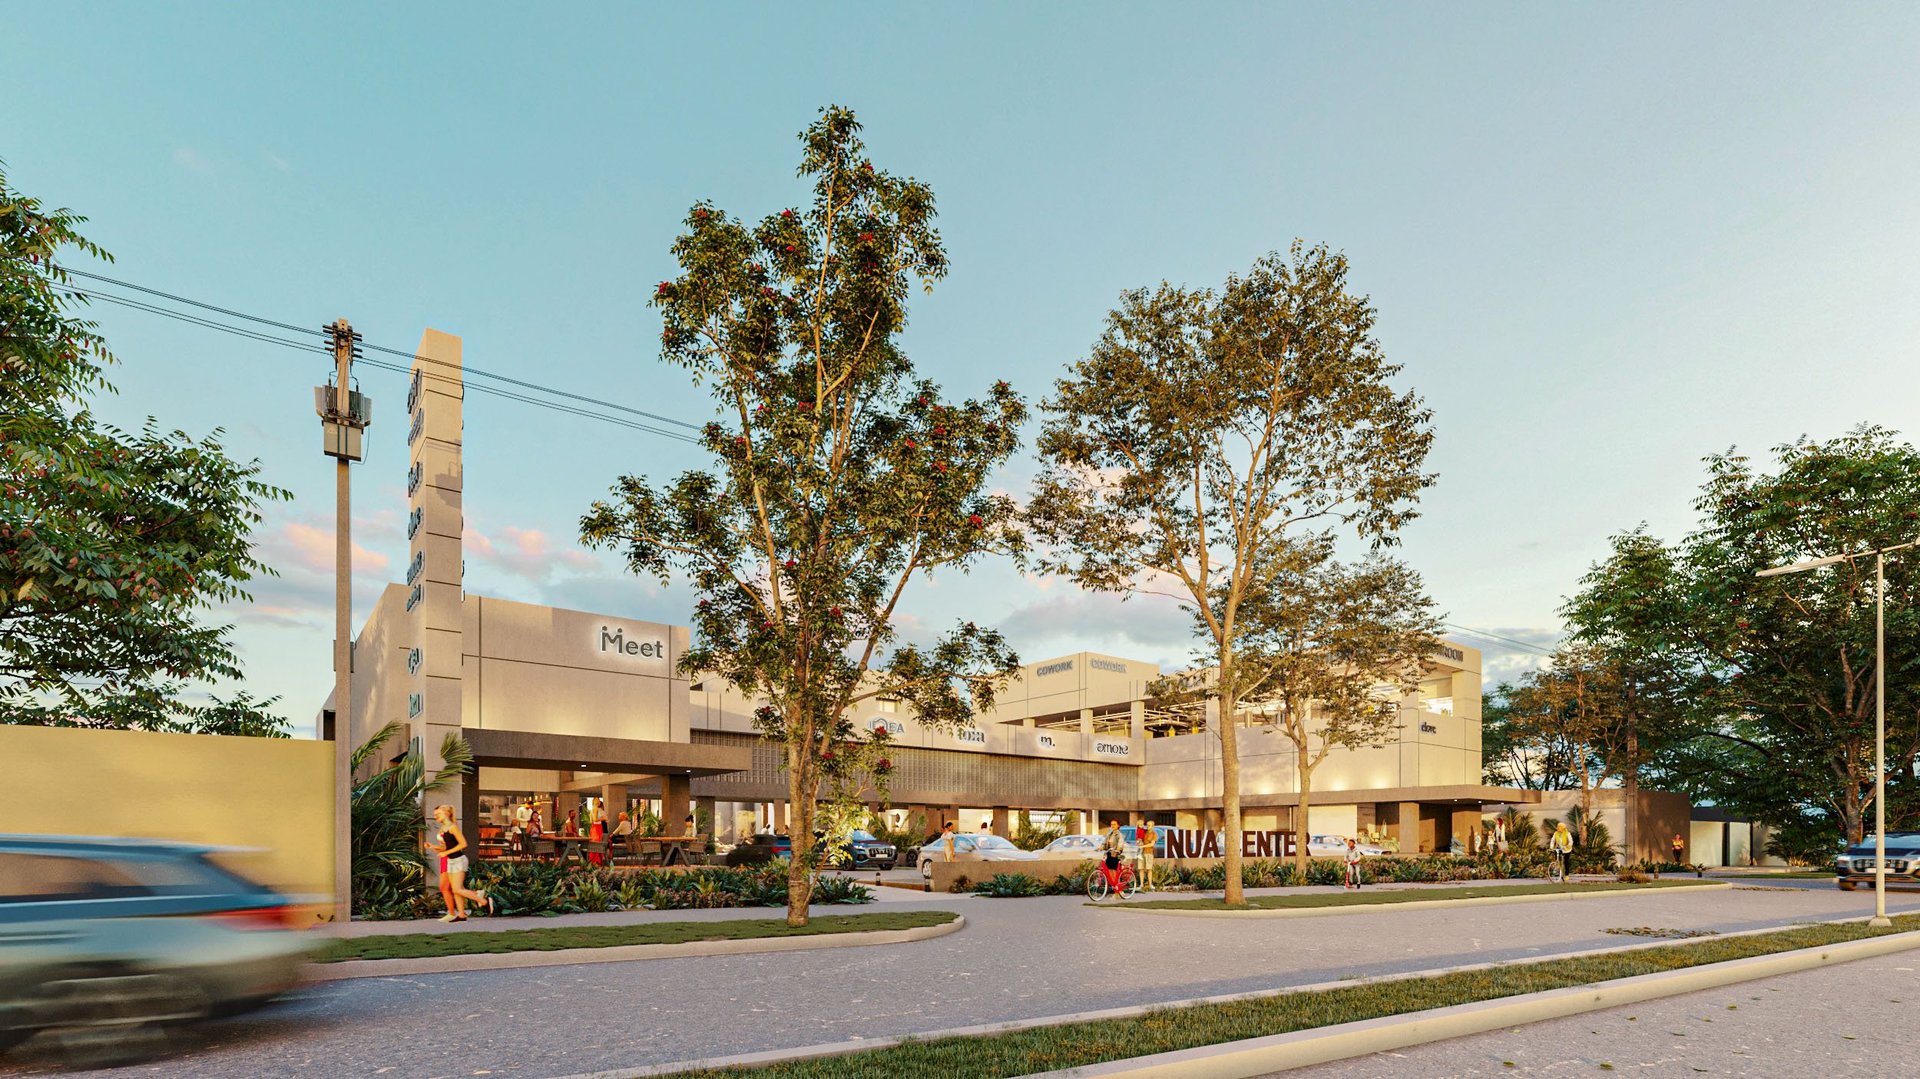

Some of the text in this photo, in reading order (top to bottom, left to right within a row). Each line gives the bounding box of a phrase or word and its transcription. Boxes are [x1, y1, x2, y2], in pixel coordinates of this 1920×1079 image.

[601, 625, 663, 659] Meet
[1037, 660, 1073, 677] COWORK
[1091, 659, 1128, 674] COWORK
[1166, 829, 1311, 858] NUA ENTE
